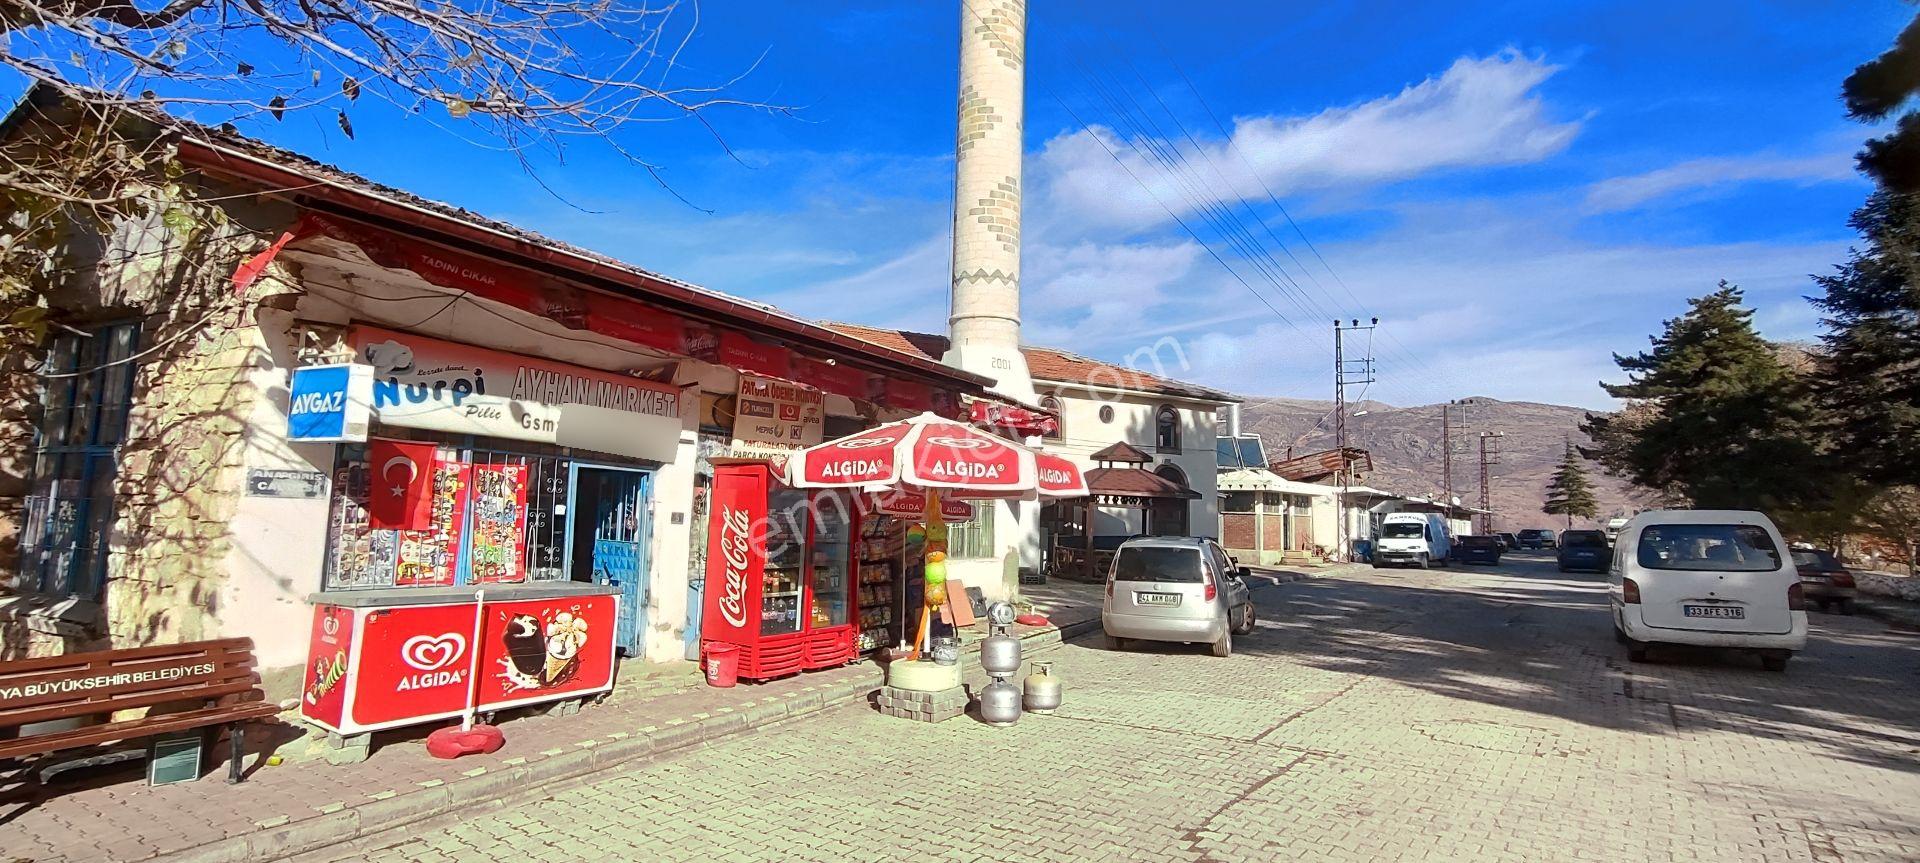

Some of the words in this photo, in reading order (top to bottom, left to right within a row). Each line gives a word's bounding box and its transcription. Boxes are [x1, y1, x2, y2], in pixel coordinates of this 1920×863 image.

[421, 255, 460, 275] TADINI
[991, 357, 1011, 371] 2001
[373, 368, 486, 409] Nurpi
[511, 365, 591, 406] AYHAN
[593, 381, 679, 418] MARKET
[291, 390, 344, 415] AYGAZ
[521, 411, 555, 432] Gsm
[803, 416, 820, 424] avea
[718, 503, 750, 628] Coca-Cola
[1690, 607, 1702, 616] 33
[1703, 607, 1721, 616] AFE
[1723, 608, 1742, 617] 316
[132, 661, 216, 683] BELEDİYESİ
[396, 669, 463, 692] ALGiDA
